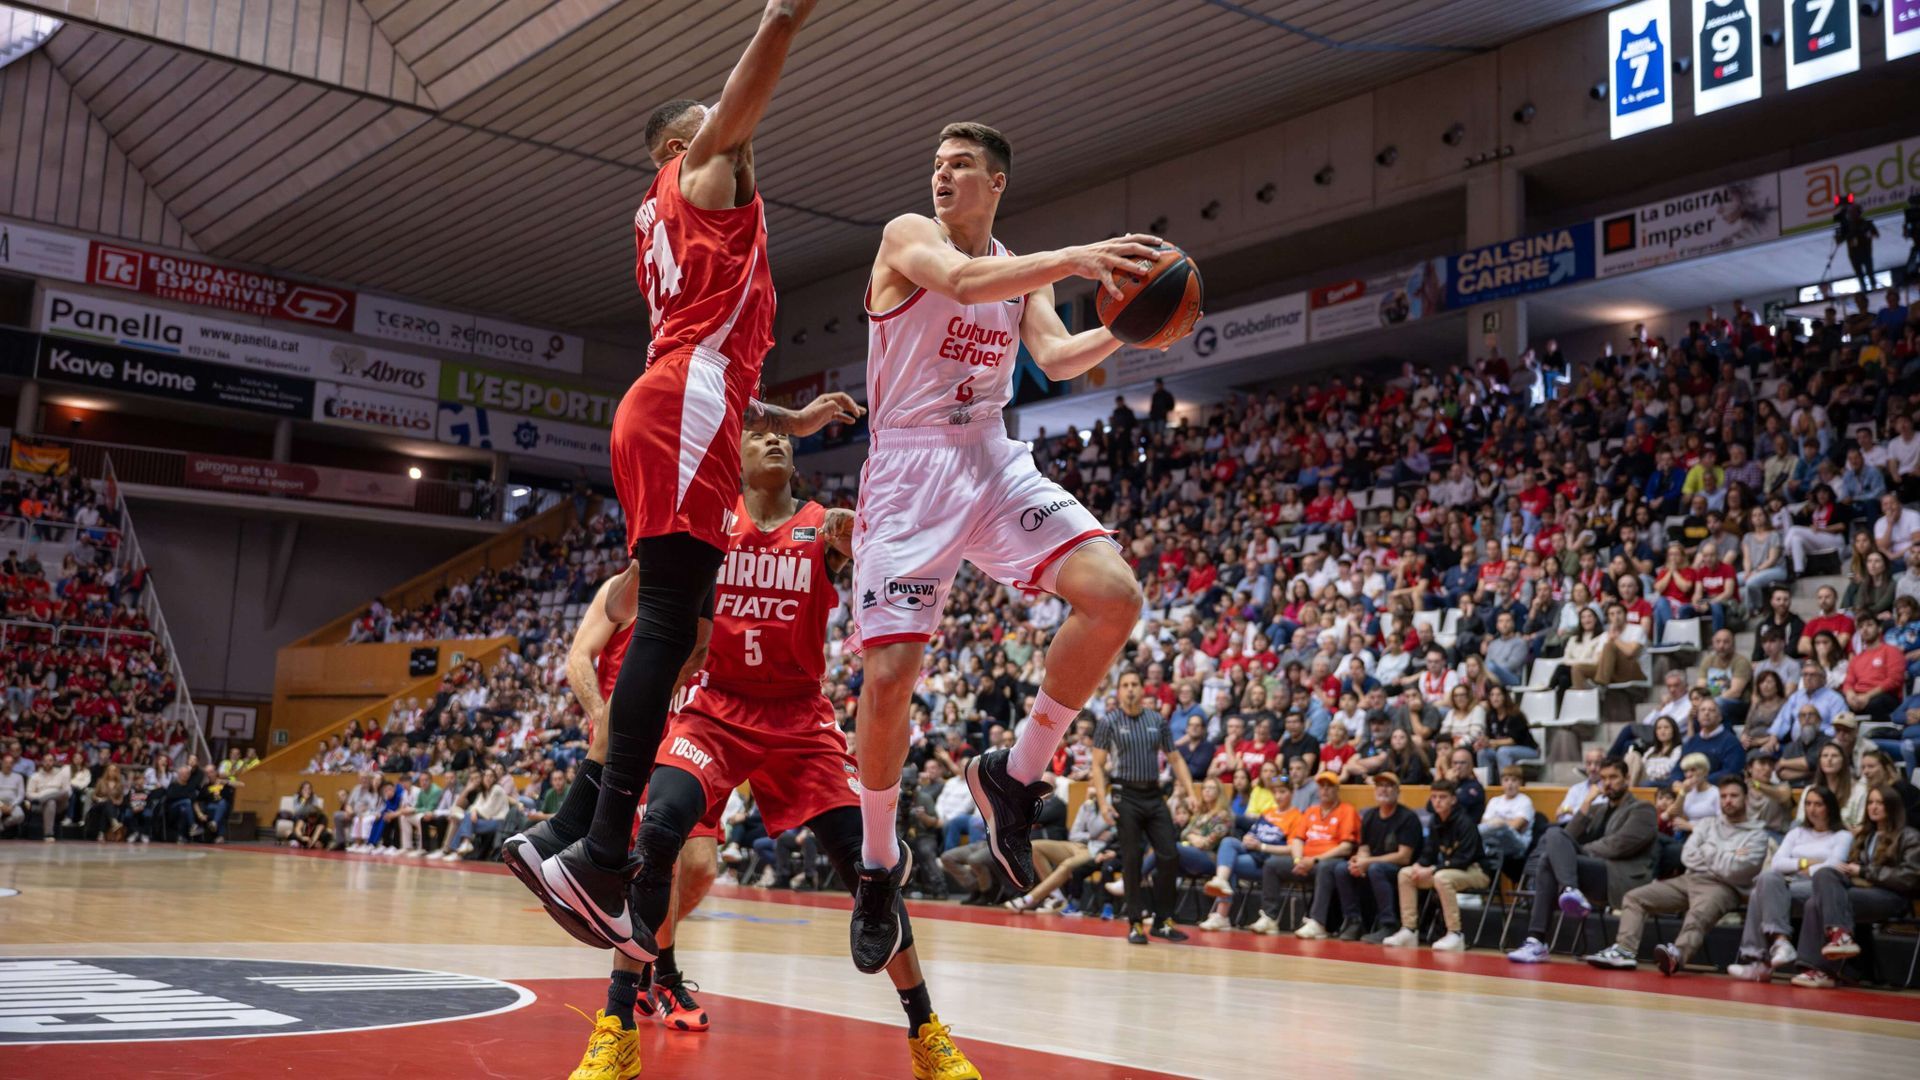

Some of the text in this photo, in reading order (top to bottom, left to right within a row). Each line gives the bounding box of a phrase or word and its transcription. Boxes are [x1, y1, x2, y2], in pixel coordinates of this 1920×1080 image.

[1806, 0, 1835, 34] 7
[1711, 25, 1740, 62] 9
[1630, 53, 1649, 88] 7
[1641, 187, 1731, 223] La DIGITAL
[1641, 216, 1716, 248] impser
[1457, 229, 1574, 273] CALSINA
[148, 256, 288, 294] EQUIPACIONS
[155, 271, 278, 307] ESPORTIVES
[50, 298, 182, 344] Panella
[1223, 311, 1302, 340] Globalimar
[200, 327, 300, 354] www.panella.cat
[49, 347, 197, 392] Kave Home
[361, 360, 426, 389] Abras
[545, 433, 603, 453] Pirineu de
[194, 459, 278, 478] girona ets tu
[222, 474, 256, 484] girona
[271, 479, 304, 490] esport
[1020, 498, 1077, 532] Midea
[728, 543, 804, 558] ASQUET
[889, 581, 935, 597] PULEVA
[715, 593, 800, 621] FIATC
[744, 629, 763, 667] 5
[668, 736, 713, 770] YOSOY
